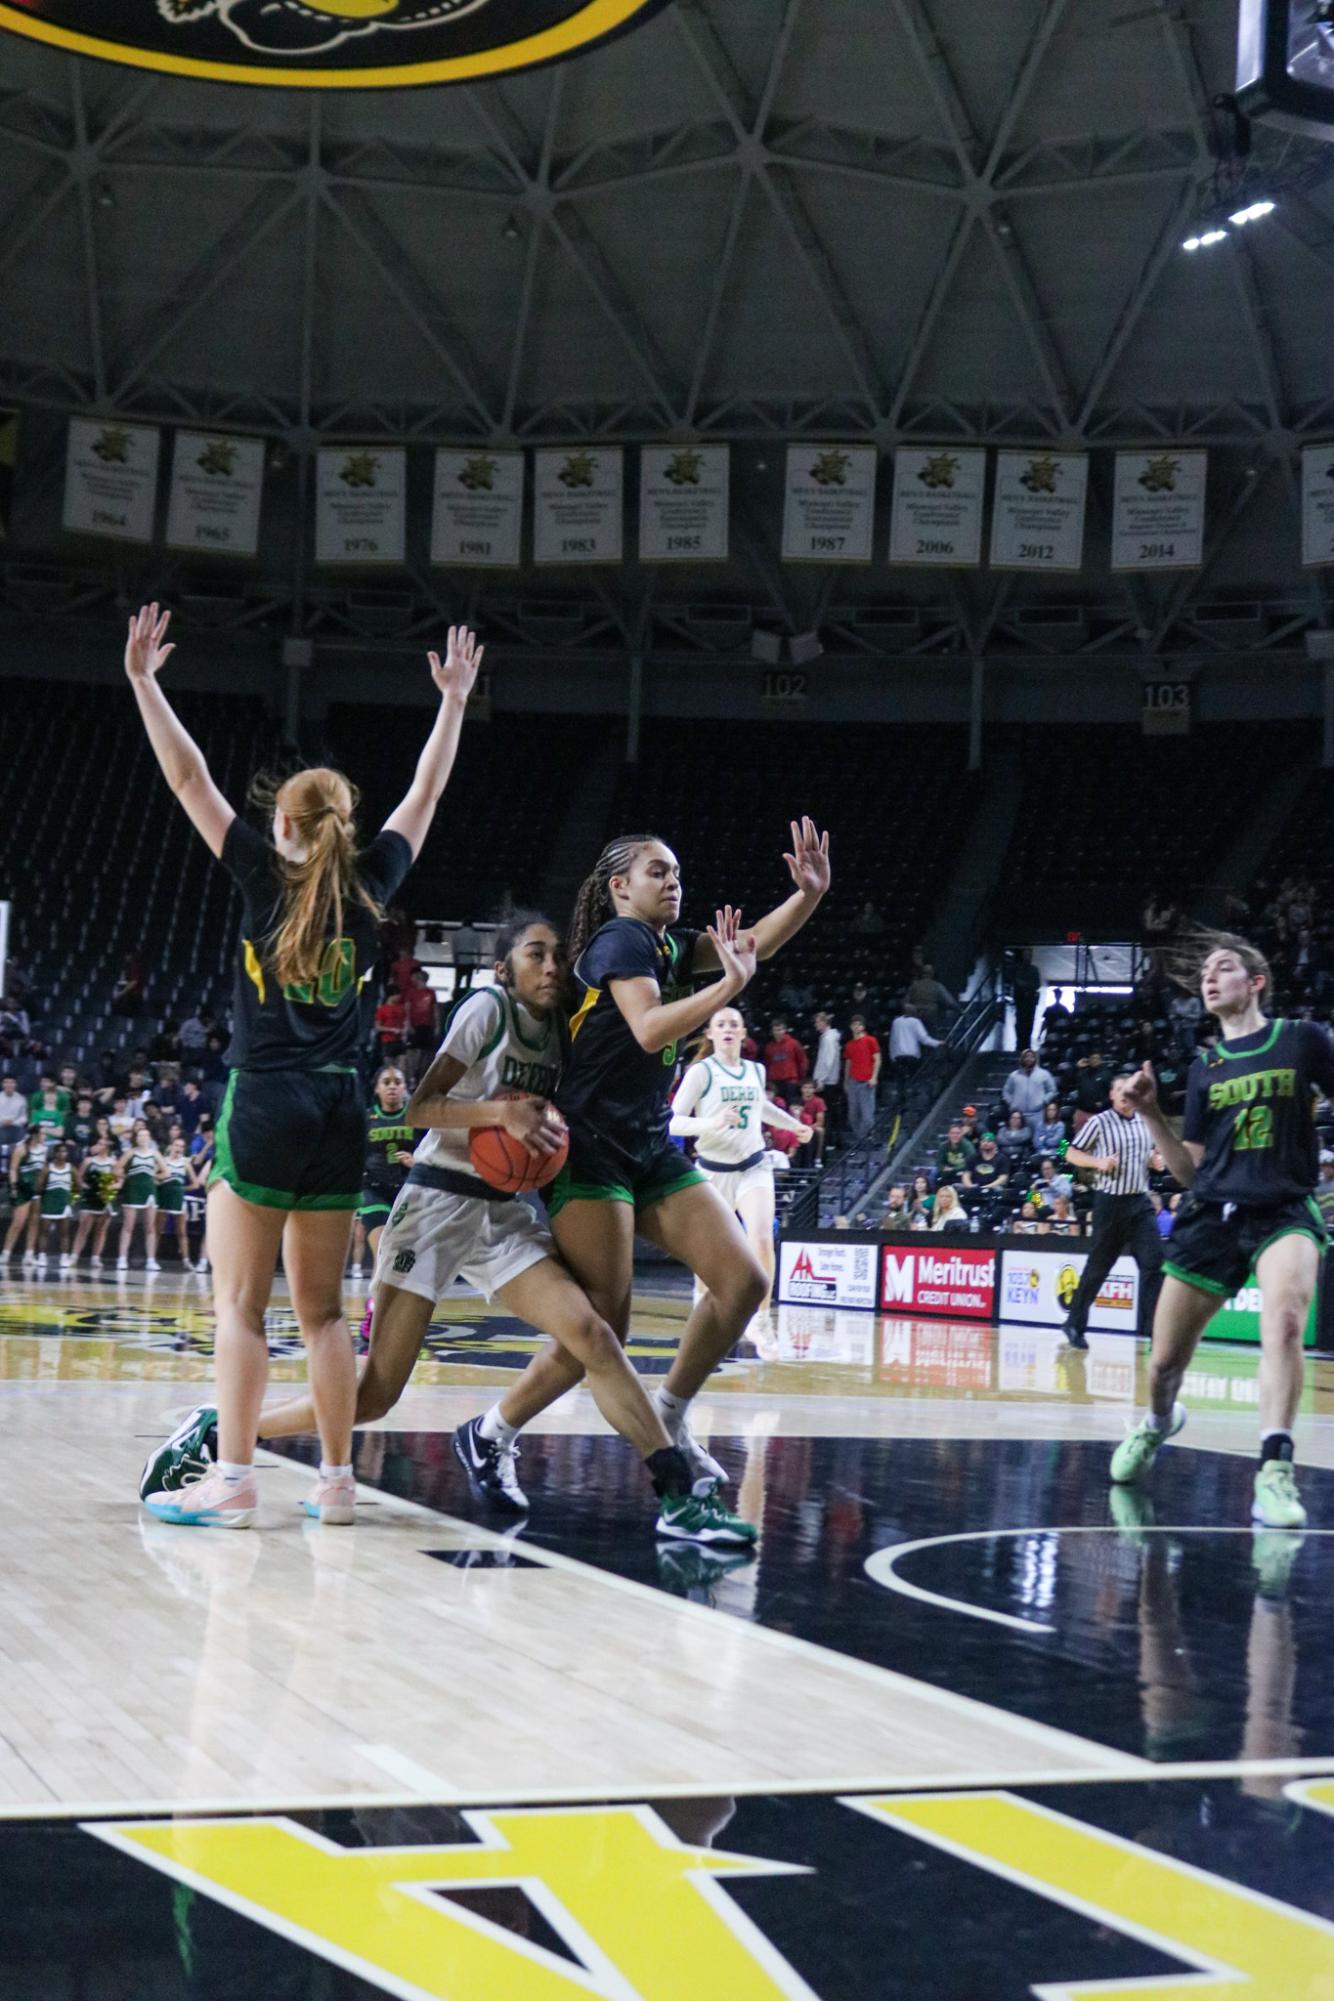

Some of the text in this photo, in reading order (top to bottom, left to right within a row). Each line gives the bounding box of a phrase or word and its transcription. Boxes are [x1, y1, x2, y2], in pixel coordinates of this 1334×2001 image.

[344, 538, 378, 552] 1976
[460, 540, 490, 554] 1981
[562, 537, 596, 552] 1983
[666, 536, 701, 550] 1985
[810, 536, 846, 551] 1987
[916, 540, 954, 554] 2006
[1018, 544, 1054, 560] 2012
[1140, 544, 1175, 559] 2014
[763, 674, 806, 697] 102
[1144, 684, 1190, 709] 103
[283, 938, 356, 1006] 0
[1209, 1069, 1296, 1110] SOUTH
[368, 1126, 413, 1142] SOUTH
[1233, 1106, 1273, 1150] 12
[386, 1143, 400, 1164] 2
[918, 1255, 995, 1288] Meritrust
[918, 1290, 949, 1306] CREDIT
[1007, 1287, 1040, 1304] KEYN
